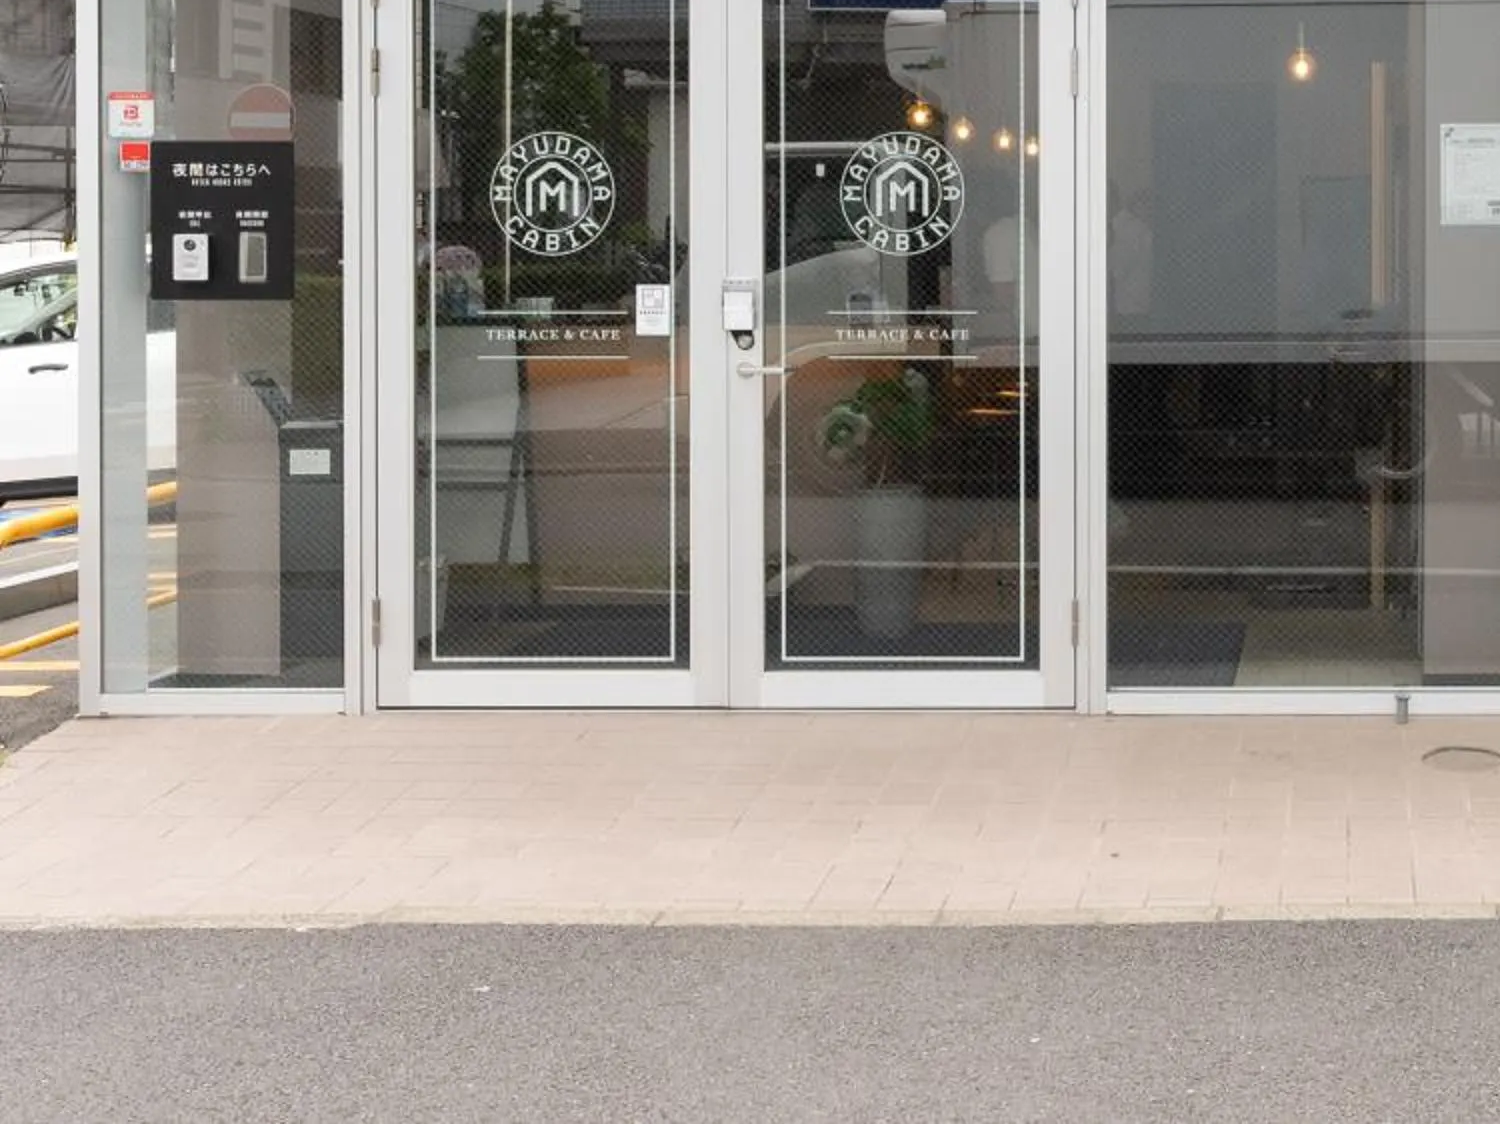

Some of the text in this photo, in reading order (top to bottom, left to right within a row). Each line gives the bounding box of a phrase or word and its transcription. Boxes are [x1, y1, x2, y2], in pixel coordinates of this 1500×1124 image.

[493, 135, 611, 202] MAYUDAMA
[843, 135, 961, 202] MAYUDAMA
[505, 215, 600, 251] CABIN
[855, 215, 950, 251] CABIN
[486, 328, 621, 341] TERRACE & CAFE
[836, 328, 970, 341] TERRACE & CAFE
